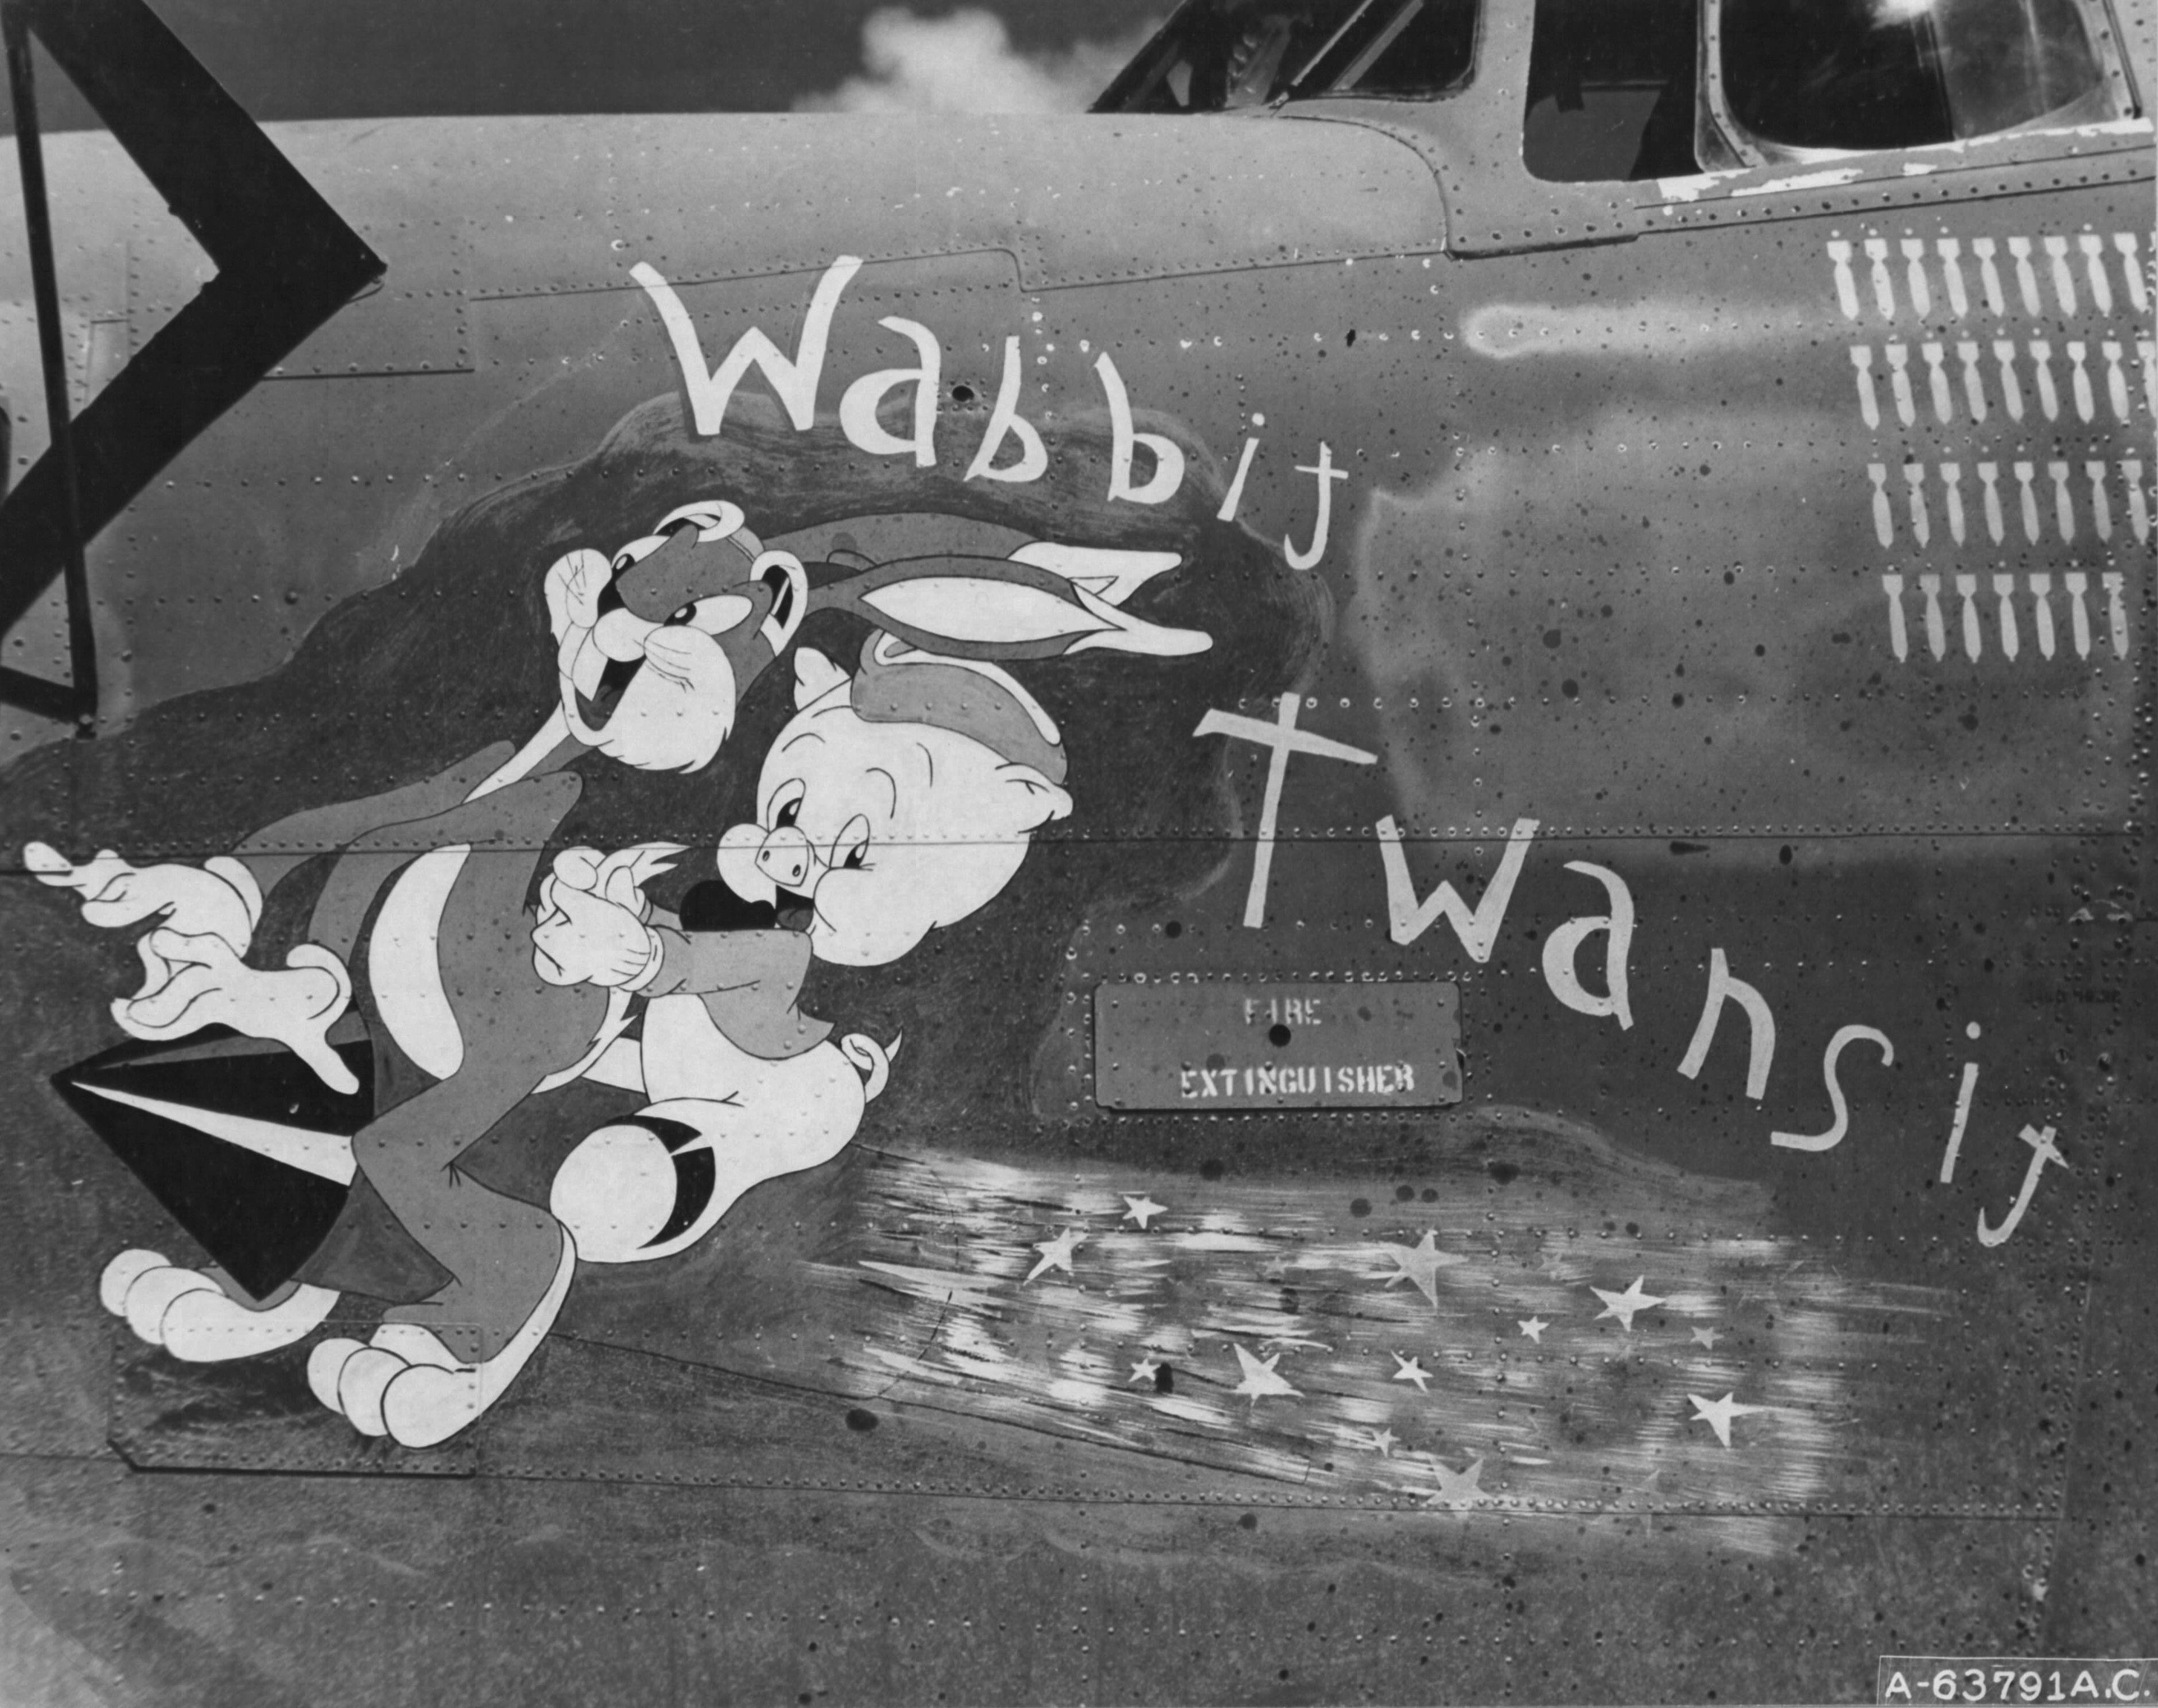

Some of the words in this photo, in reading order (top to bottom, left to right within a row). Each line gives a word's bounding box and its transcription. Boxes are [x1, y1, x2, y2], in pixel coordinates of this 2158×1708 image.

[628, 255, 1349, 570] Wabbit
[1244, 998, 1322, 1025] FIRE
[1181, 1063, 1415, 1098] EXTINGUISHER
